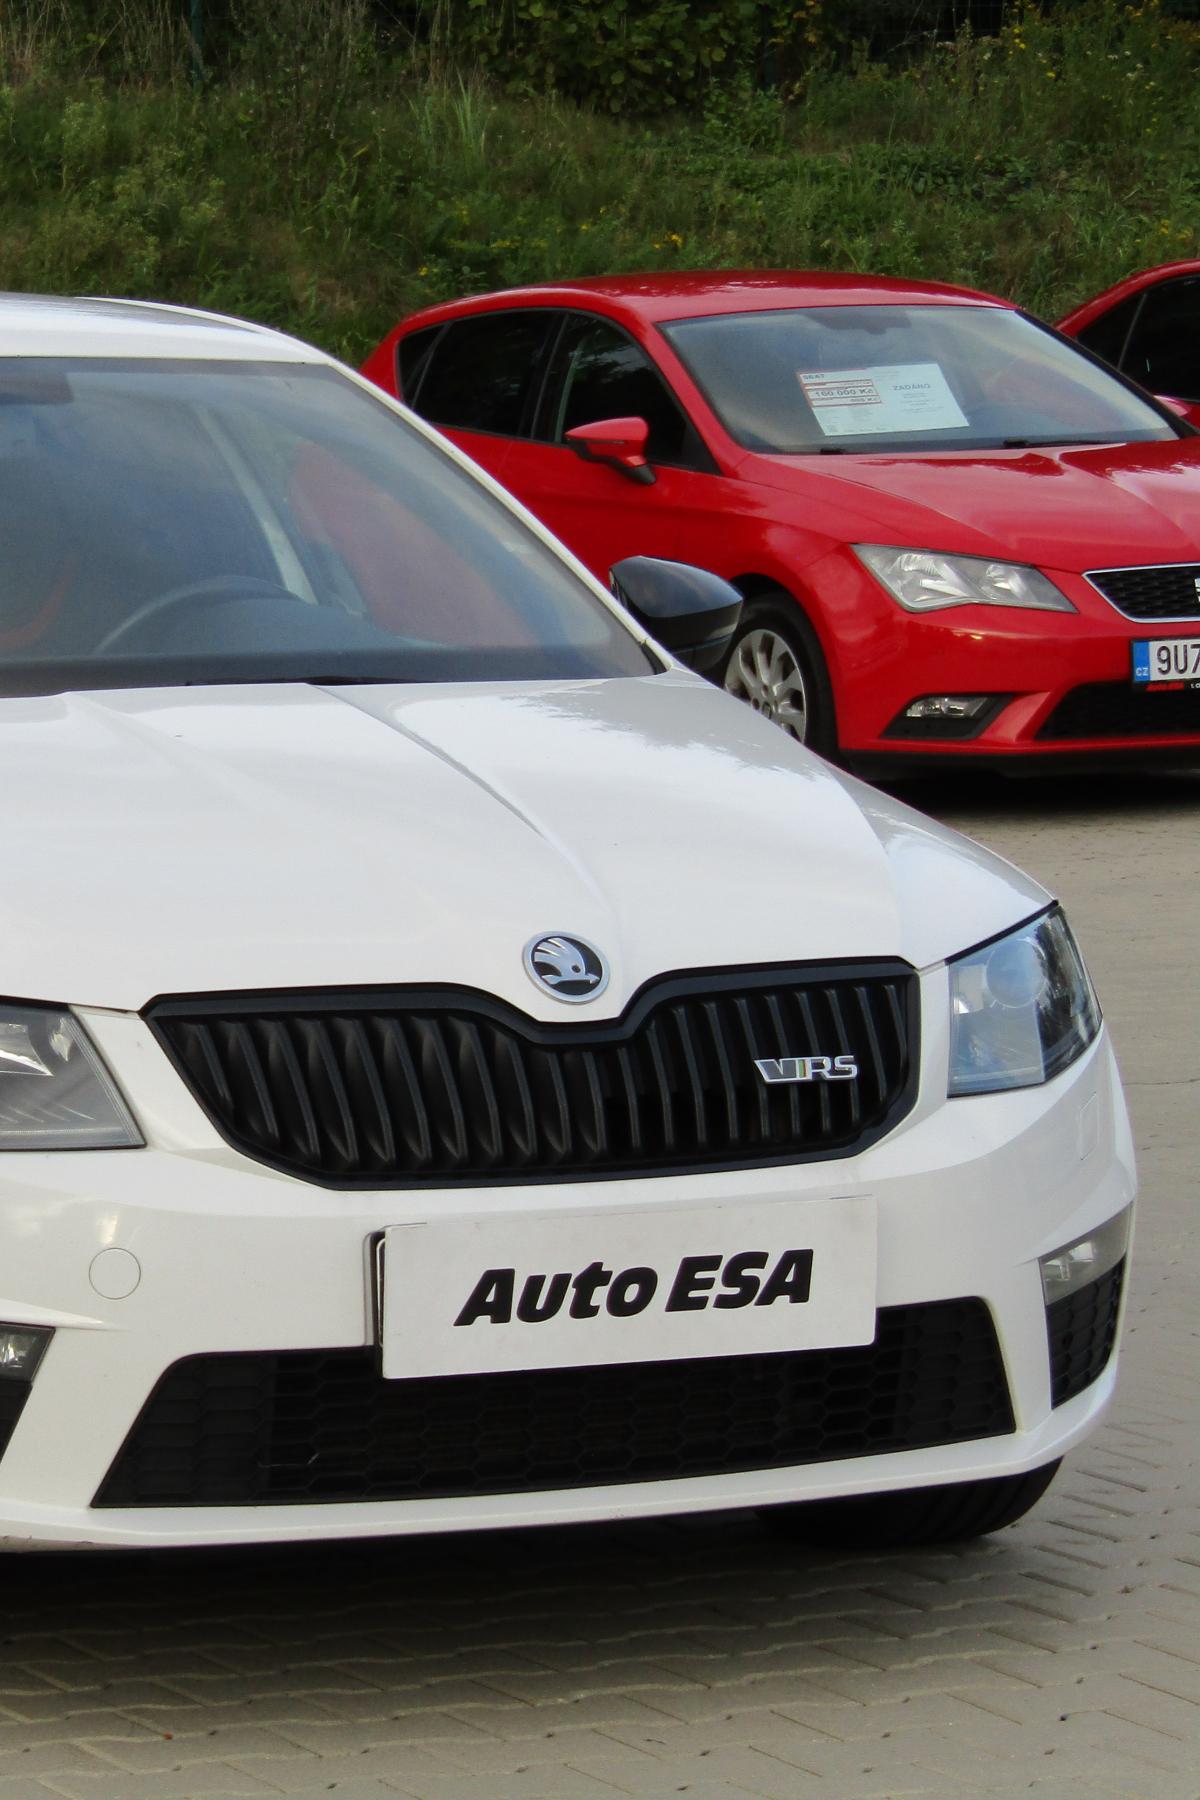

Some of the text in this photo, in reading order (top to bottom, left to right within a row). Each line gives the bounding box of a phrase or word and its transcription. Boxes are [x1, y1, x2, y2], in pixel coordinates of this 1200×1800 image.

[1135, 667, 1149, 676] CZ
[453, 1248, 815, 1326] Auto ESA
